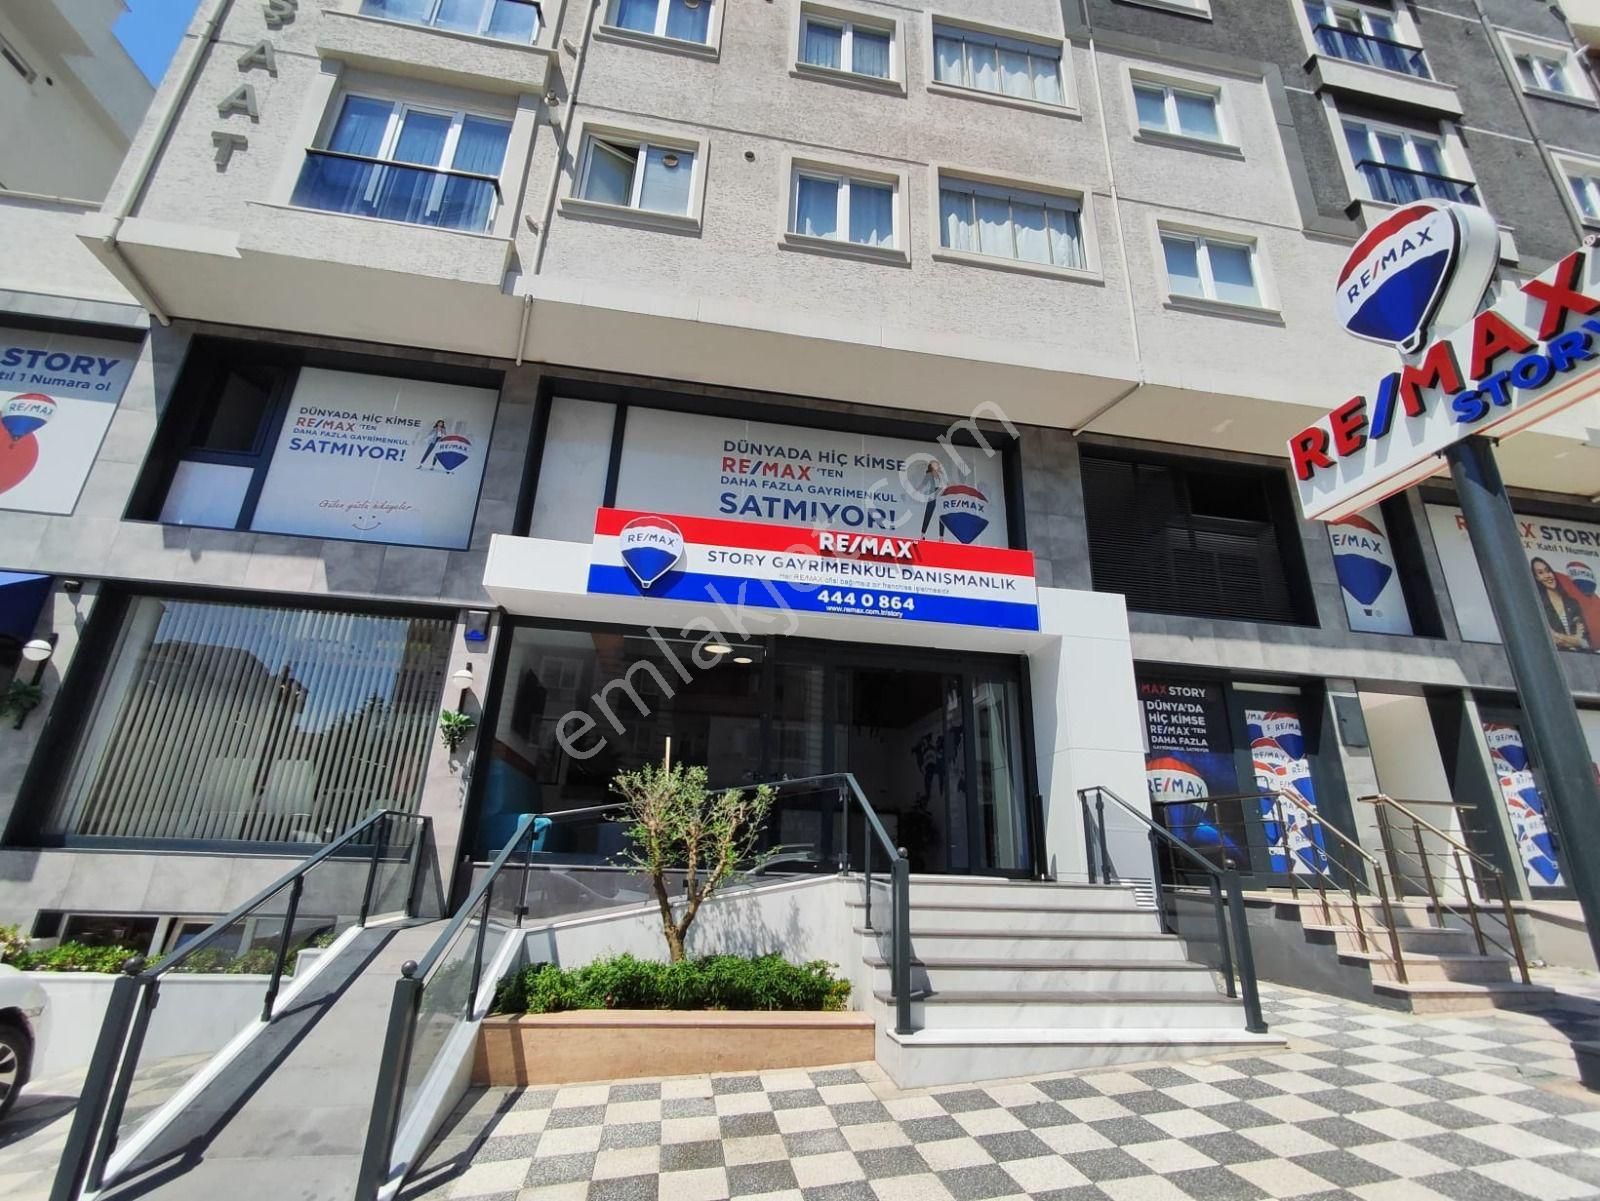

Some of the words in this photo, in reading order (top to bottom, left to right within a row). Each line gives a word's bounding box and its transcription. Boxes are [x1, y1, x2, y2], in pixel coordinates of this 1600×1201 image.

[1346, 225, 1434, 304] RE/MAX
[0, 347, 120, 377] STORY
[1288, 249, 1600, 483] RE/MAX
[30, 374, 91, 390] Numara
[95, 382, 112, 392] ol
[296, 417, 356, 432] RE/MAX
[299, 406, 358, 420] DÜNYADA
[361, 412, 383, 424] HİÇ
[385, 415, 422, 428] KİMSE
[292, 427, 319, 436] DAHA
[320, 430, 348, 440] FAZLA
[289, 437, 406, 462] SATMIYOR!
[439, 443, 468, 451] RE/MAX
[723, 439, 812, 462] DÜNYADA
[818, 448, 849, 467] HİÇ
[854, 453, 906, 472] KİMSE
[721, 456, 812, 481] RE/MAX
[720, 475, 758, 488] DAHA
[762, 479, 804, 493] FAZLA
[807, 485, 898, 503] GAYRİMENKUL
[719, 491, 896, 530] SATMIYOR!
[943, 499, 985, 513] RE/MAX
[628, 533, 676, 547] RE/MAX
[818, 532, 913, 559] RE/MAX
[707, 549, 766, 567] STORY
[772, 555, 897, 580] GAYRİMENKUL
[901, 567, 1017, 591] DANIŞMANLIK
[817, 590, 856, 606] 444
[861, 594, 874, 607] 0
[879, 595, 915, 611] 864
[1168, 686, 1206, 698] STORY
[1146, 699, 1204, 713] DÜNYA'DA
[1148, 711, 1169, 725] HİÇ
[1170, 713, 1206, 726] KİMSE
[1150, 725, 1190, 736] RE/MAX
[1151, 735, 1178, 745] DAHA
[1178, 737, 1208, 746] FAZLA
